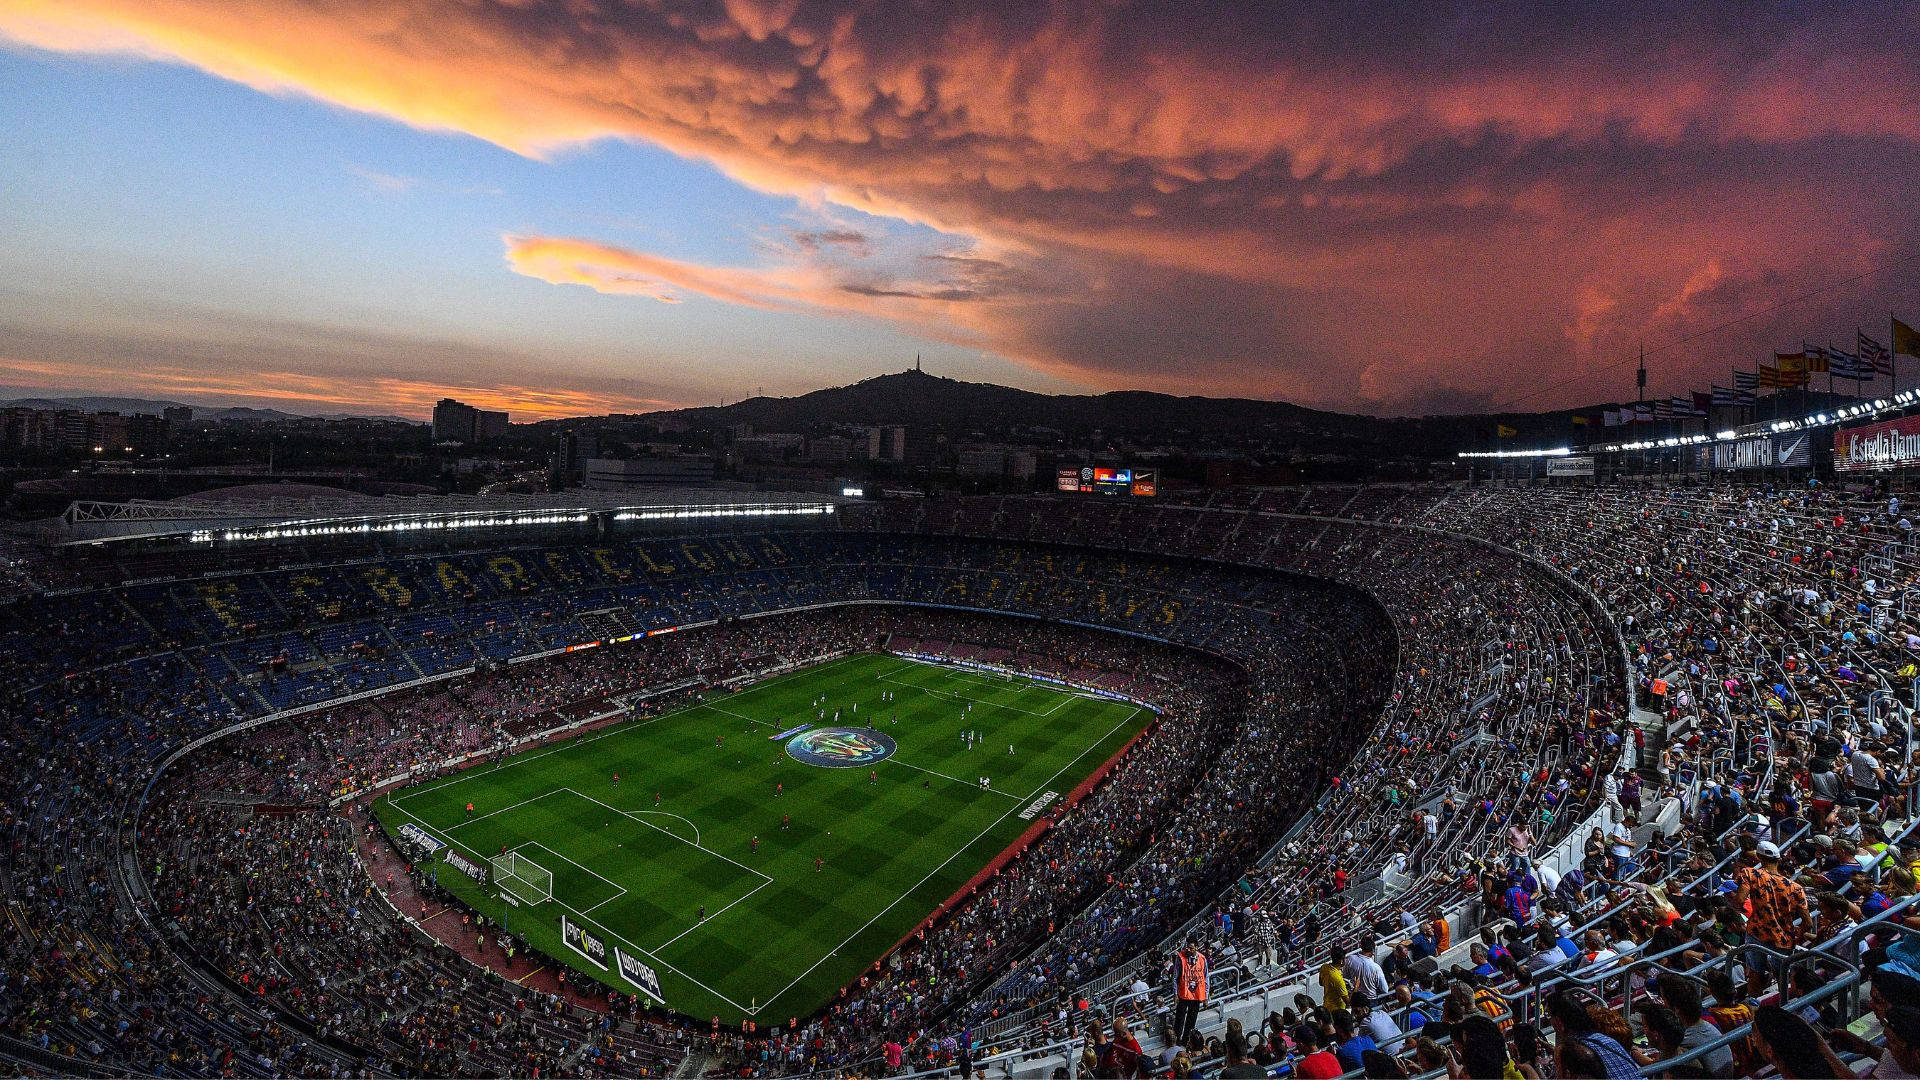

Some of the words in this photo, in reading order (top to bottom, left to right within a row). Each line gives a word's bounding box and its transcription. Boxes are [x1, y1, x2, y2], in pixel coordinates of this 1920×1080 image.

[1715, 439, 1772, 468] NIKE.COM/FCB
[1850, 432, 1889, 463] Estrella
[364, 536, 789, 608] BARCELONA
[240, 716, 268, 729] KONAMI
[277, 707, 307, 718] KONAMI
[316, 698, 344, 709] KONAMI
[352, 689, 379, 700] KONAMI
